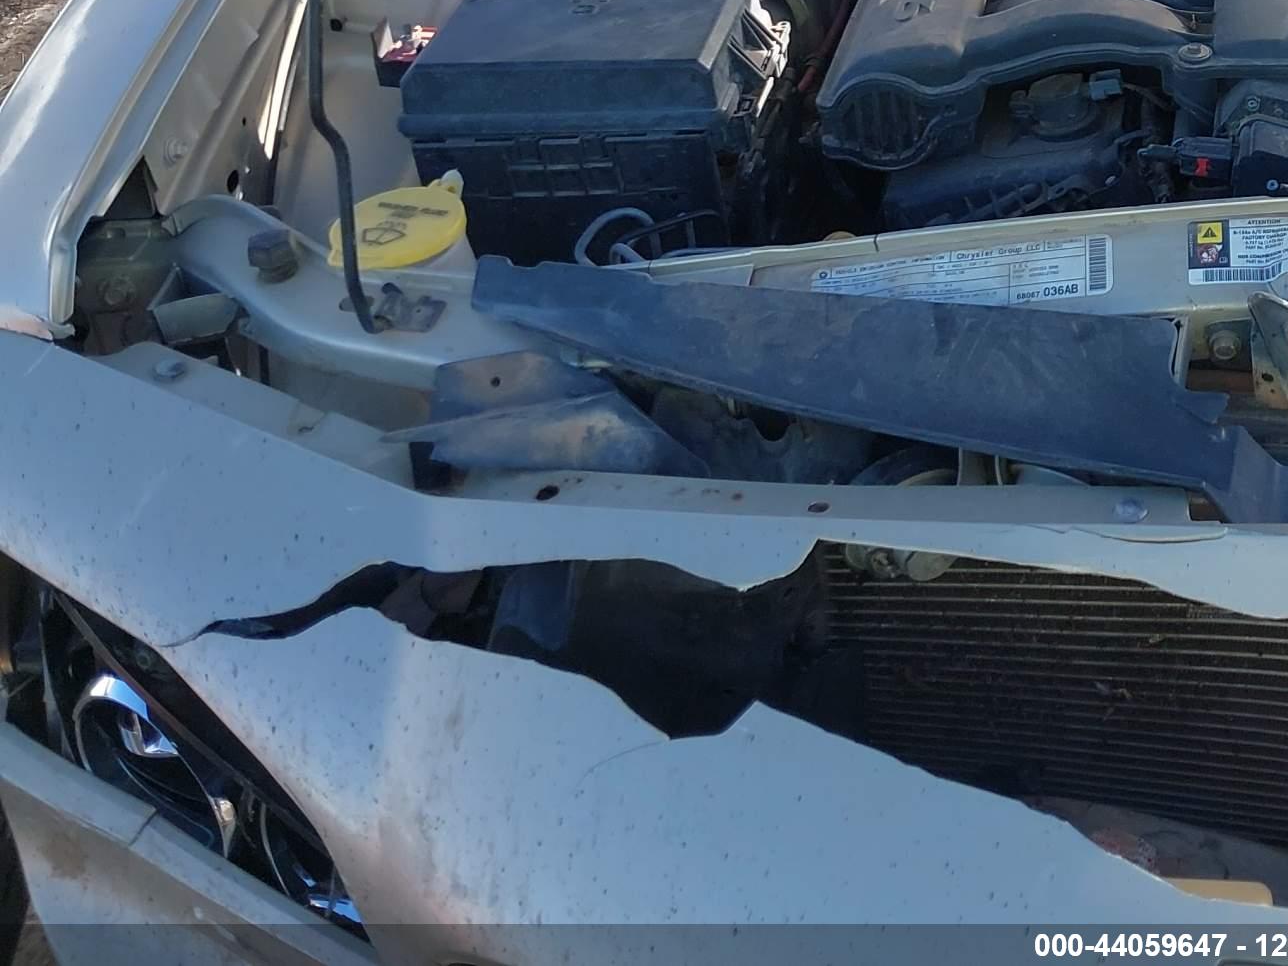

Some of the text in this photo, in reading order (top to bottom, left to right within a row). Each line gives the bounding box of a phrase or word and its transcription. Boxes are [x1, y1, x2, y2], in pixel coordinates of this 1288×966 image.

[956, 249, 993, 261] Chrysler
[998, 247, 1022, 255] Group
[1026, 242, 1041, 251] LLC
[1043, 283, 1079, 297] 036AB
